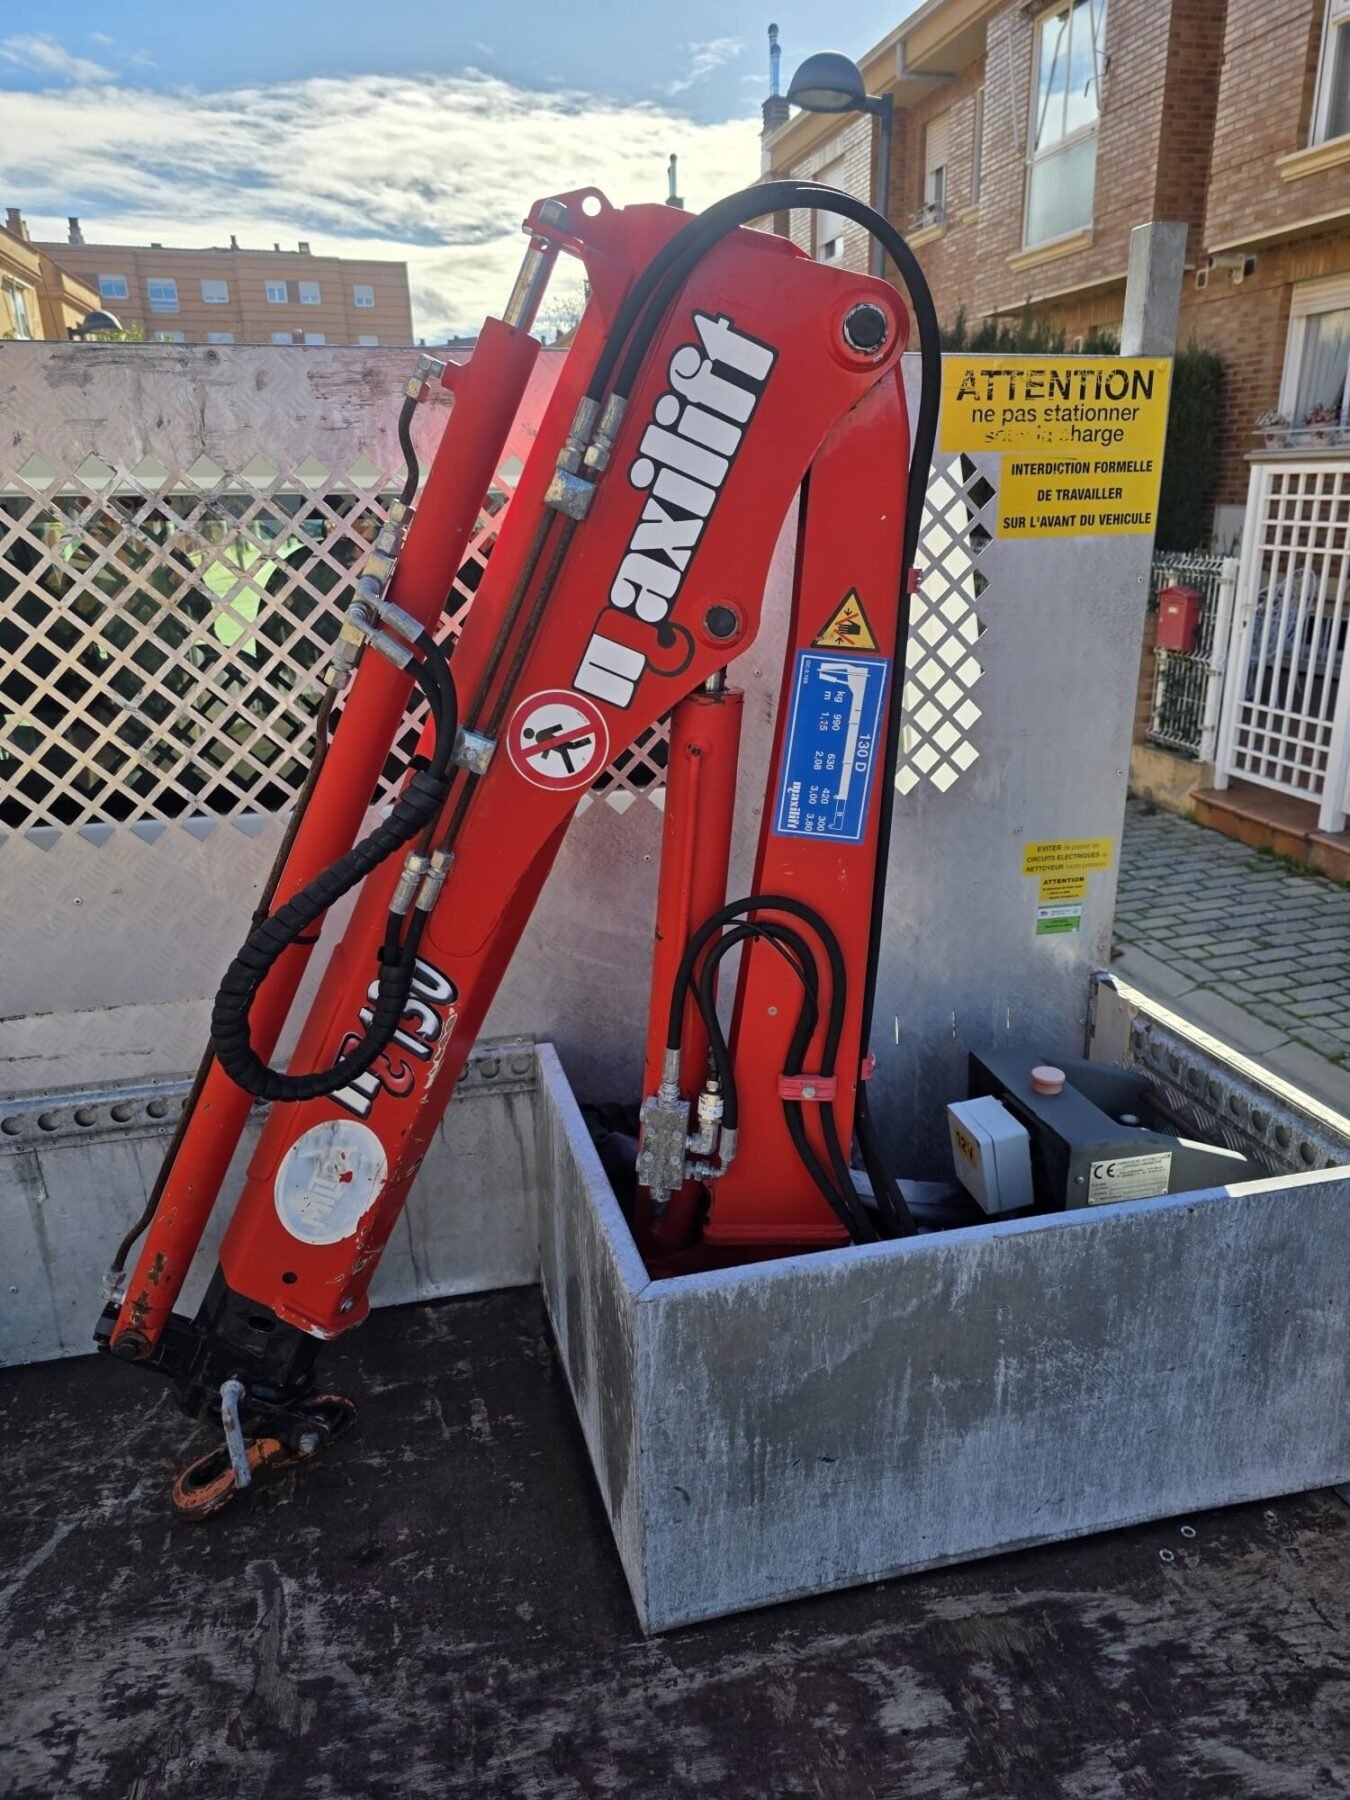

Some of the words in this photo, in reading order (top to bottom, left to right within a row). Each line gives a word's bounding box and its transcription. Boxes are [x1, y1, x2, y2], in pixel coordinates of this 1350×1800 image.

[955, 369, 1154, 401] ATTENTION
[972, 408, 995, 422] ne
[1002, 407, 1037, 425] pas
[1043, 404, 1140, 422] stationner
[1011, 462, 1090, 476] INTERDICTION
[1094, 460, 1153, 473] FORMELLE
[1037, 489, 1052, 502] DE
[1056, 487, 1123, 501] TRAVAILLER
[571, 309, 778, 710] maxilift
[1003, 516, 1026, 529] SUR
[1030, 514, 1076, 528] L'AVANT
[1080, 514, 1095, 526] DU
[1099, 512, 1152, 525] VEHICULE
[824, 691, 831, 700] m
[834, 691, 846, 703] kg
[832, 713, 842, 731] 990
[857, 734, 871, 758] 130
[813, 751, 824, 770] 2,08
[826, 753, 836, 770] 630
[855, 762, 867, 772] D
[808, 785, 818, 804] 3,00
[820, 787, 830, 804] 420
[787, 782, 801, 829] maxilift
[804, 813, 815, 831] 3,80
[816, 815, 826, 831] 300
[1037, 844, 1063, 853] EVITER
[1026, 855, 1055, 863] CIRCUITS
[1057, 852, 1100, 861] ELECTRIQUES
[1026, 864, 1064, 873] NETTOYEUR
[1043, 877, 1085, 885] ATTENTION
[1093, 1163, 1116, 1180] CE
